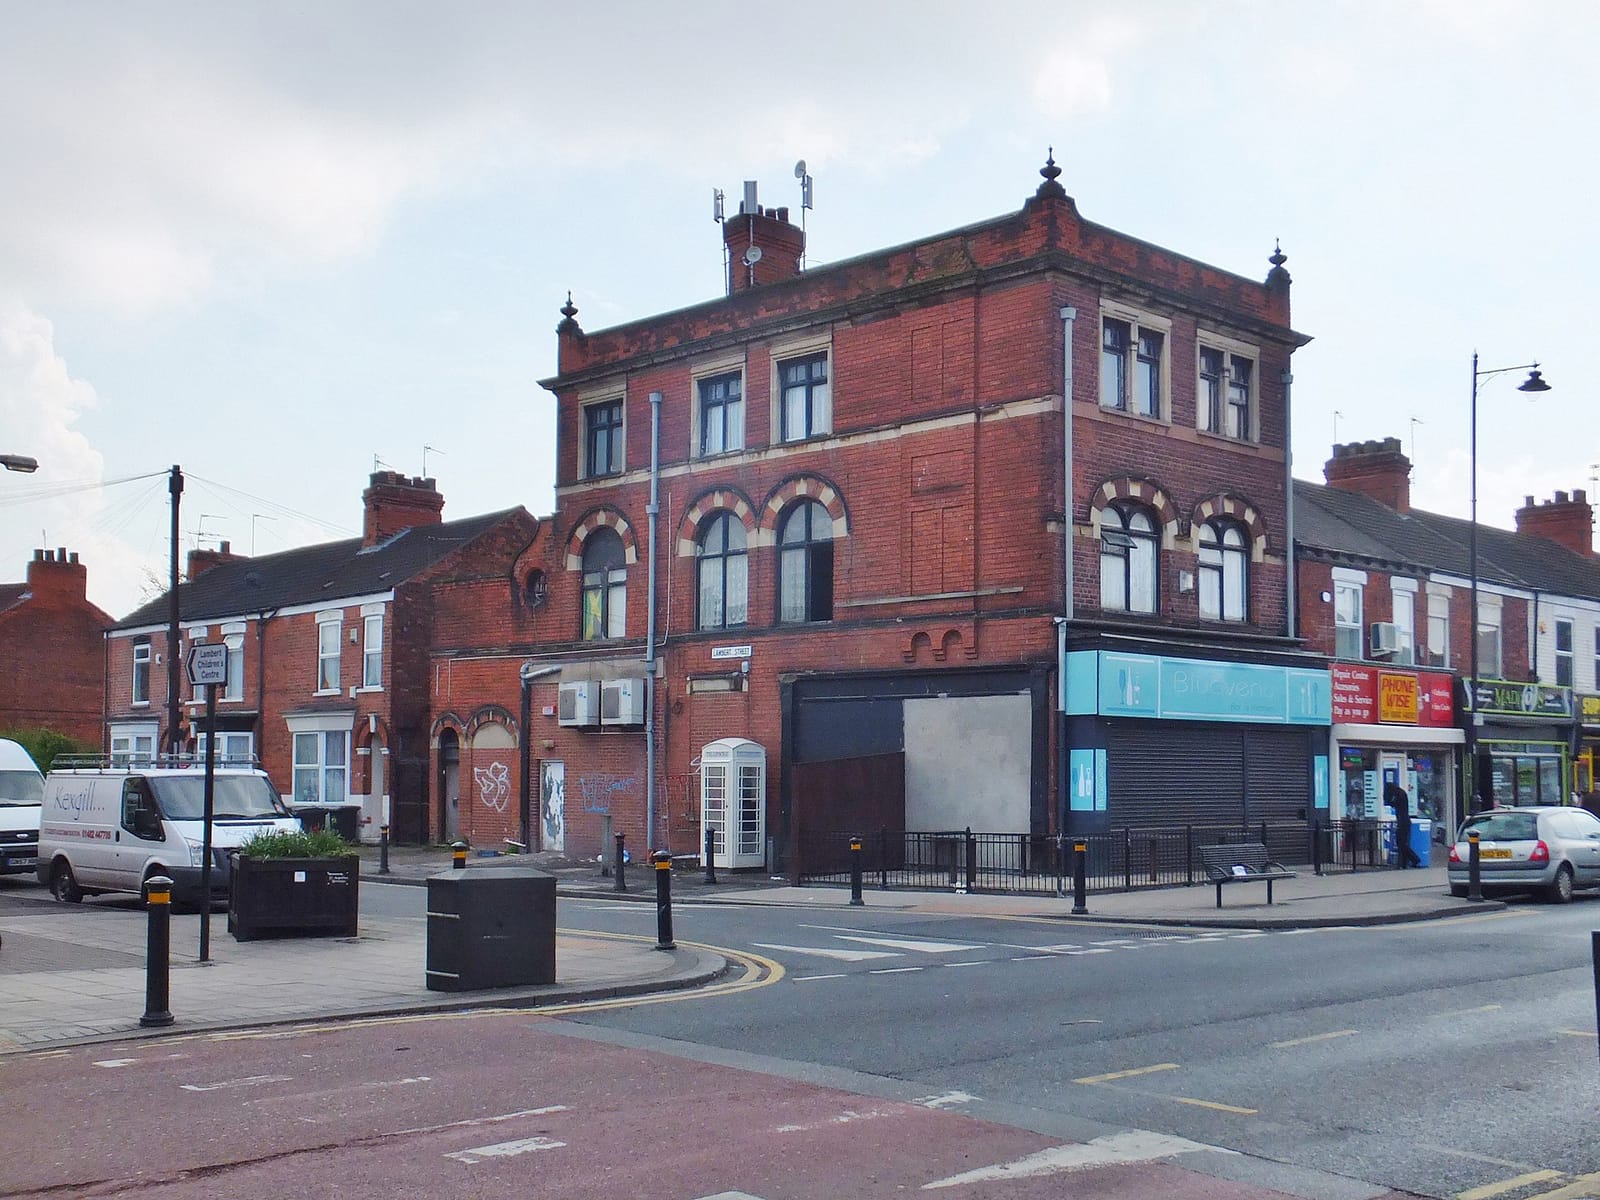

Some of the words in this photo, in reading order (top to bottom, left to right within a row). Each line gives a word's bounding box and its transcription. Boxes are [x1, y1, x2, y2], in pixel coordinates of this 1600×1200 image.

[200, 649, 222, 658] Lambert
[713, 648, 731, 657] LAMBERT
[735, 647, 750, 656] STREET
[201, 670, 220, 679] Centre
[1333, 669, 1350, 680] Repair
[1382, 678, 1415, 693] PHONE
[1333, 693, 1346, 703] Sales
[1348, 695, 1353, 703] &
[1355, 696, 1373, 705] Service
[1386, 694, 1411, 707] WISE
[1333, 706, 1343, 717] Pay
[1352, 709, 1361, 718] you
